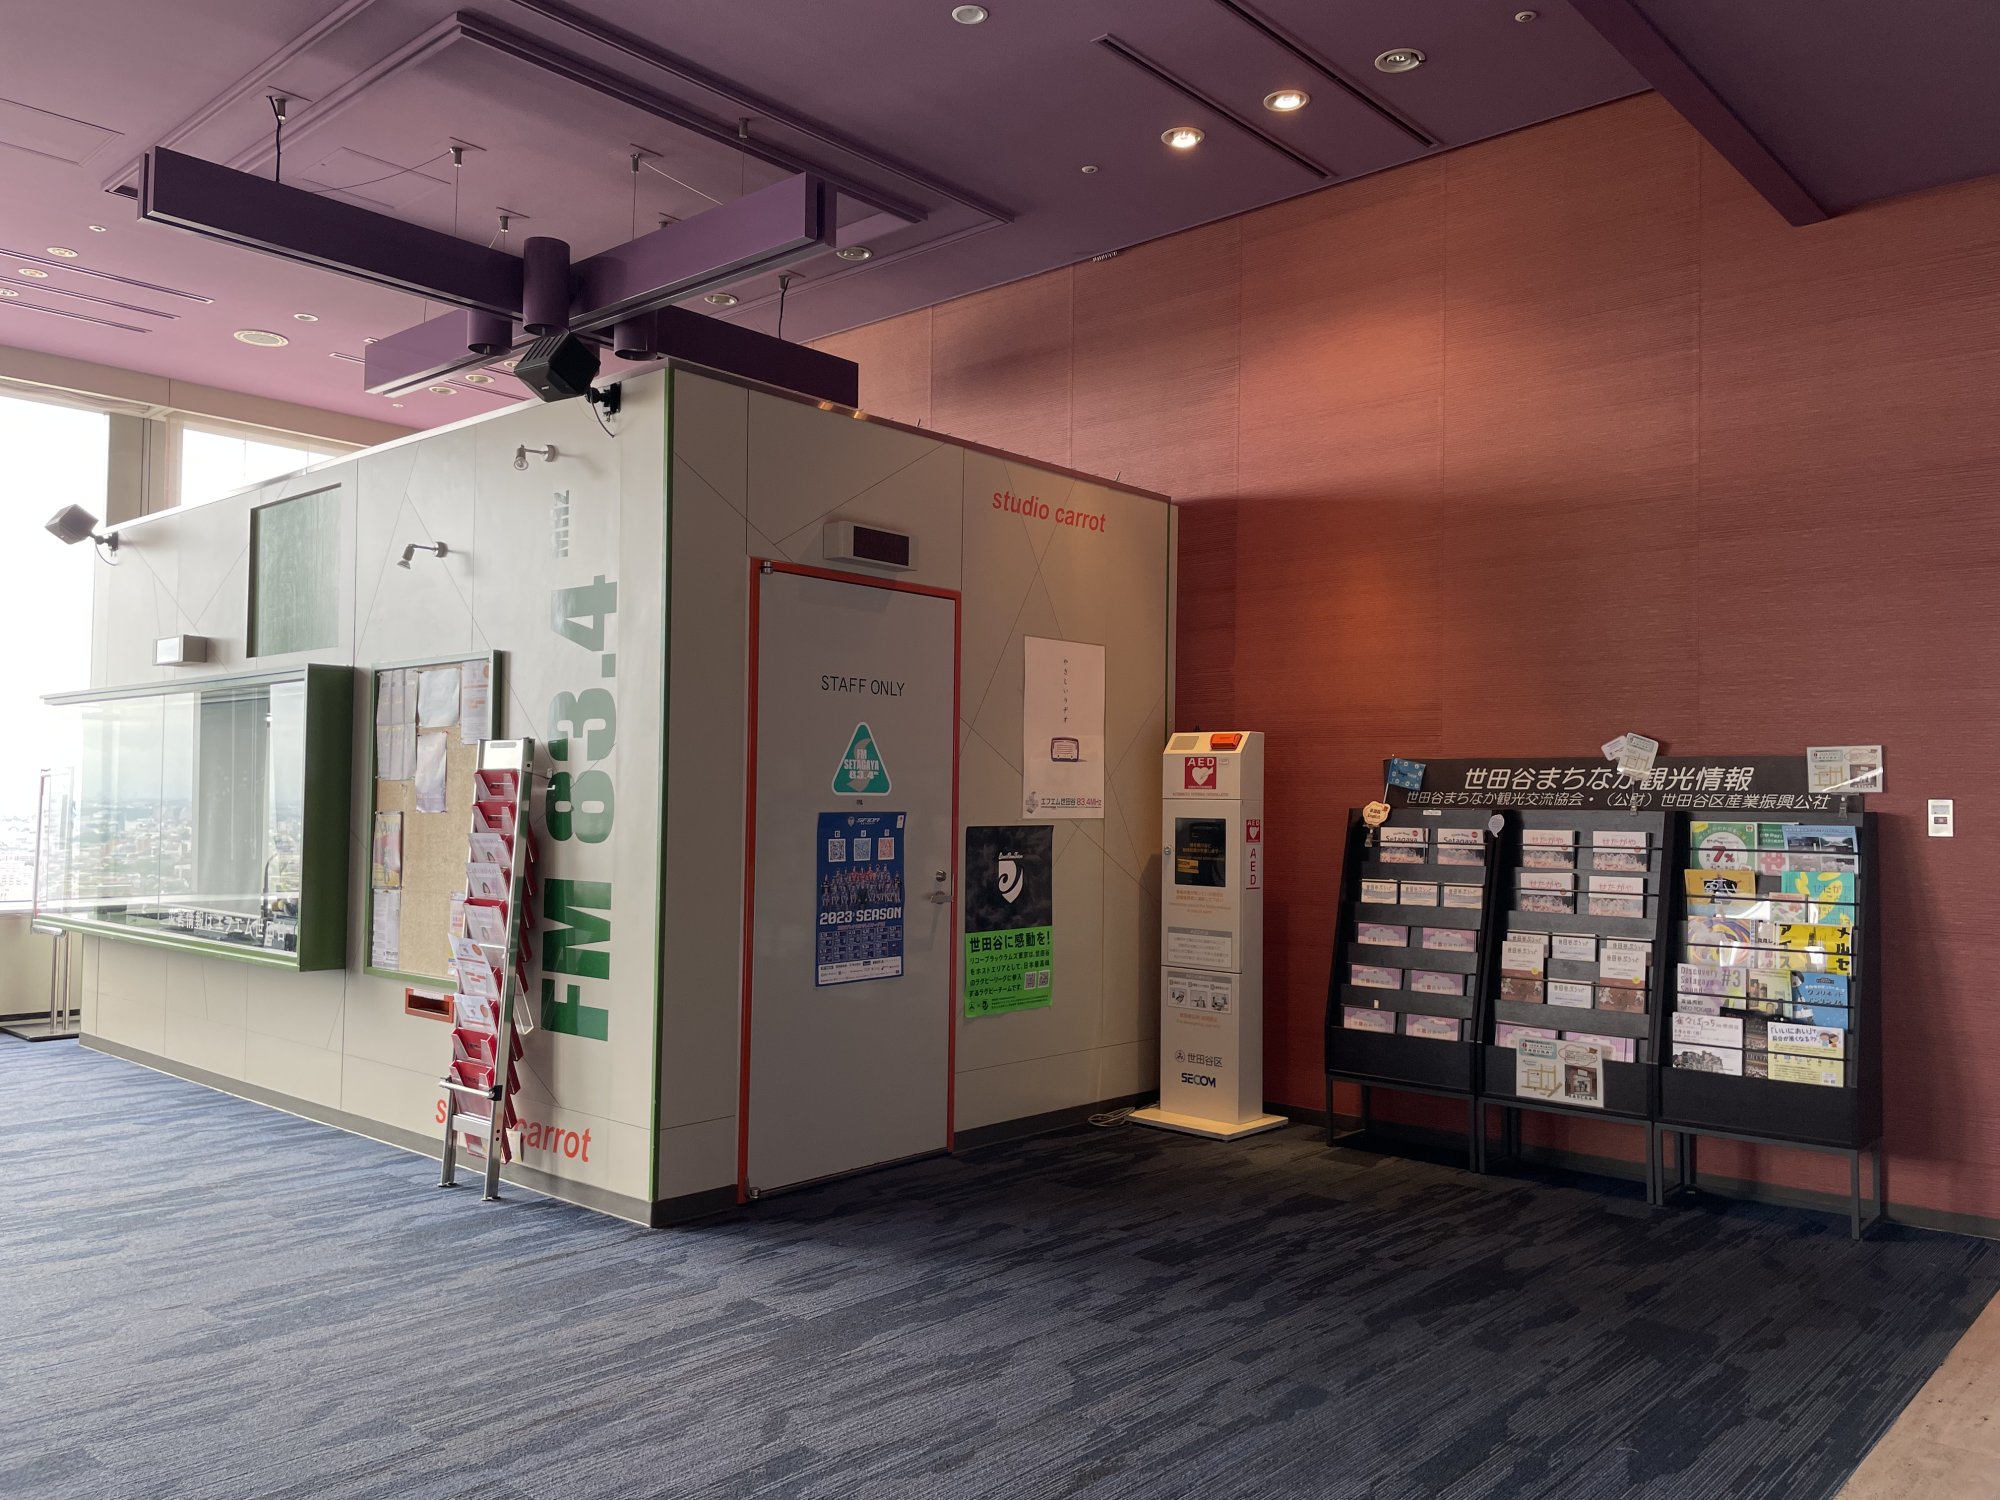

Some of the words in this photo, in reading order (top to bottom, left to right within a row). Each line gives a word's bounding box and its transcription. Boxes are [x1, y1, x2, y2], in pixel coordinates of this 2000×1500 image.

[992, 490, 1050, 521] studio
[1055, 504, 1106, 533] carrot
[821, 675, 867, 693] STAFF
[870, 679, 905, 697] ONLY
[546, 574, 618, 844] 83.4
[856, 749, 867, 759] FM
[1187, 757, 1215, 767] AED
[843, 759, 880, 771] SETAGAYA
[849, 770, 874, 779] 83.4
[1041, 797, 1076, 806] エフエム世田谷
[1249, 847, 1257, 885] AED
[819, 910, 853, 925] 2023
[855, 906, 902, 922] SEASON
[969, 930, 1050, 953] 世田谷に感動を！
[541, 878, 612, 1042] FM
[1722, 968, 1742, 988] #3
[1187, 1052, 1223, 1068] 世田谷区
[1181, 1072, 1217, 1089] SECOM
